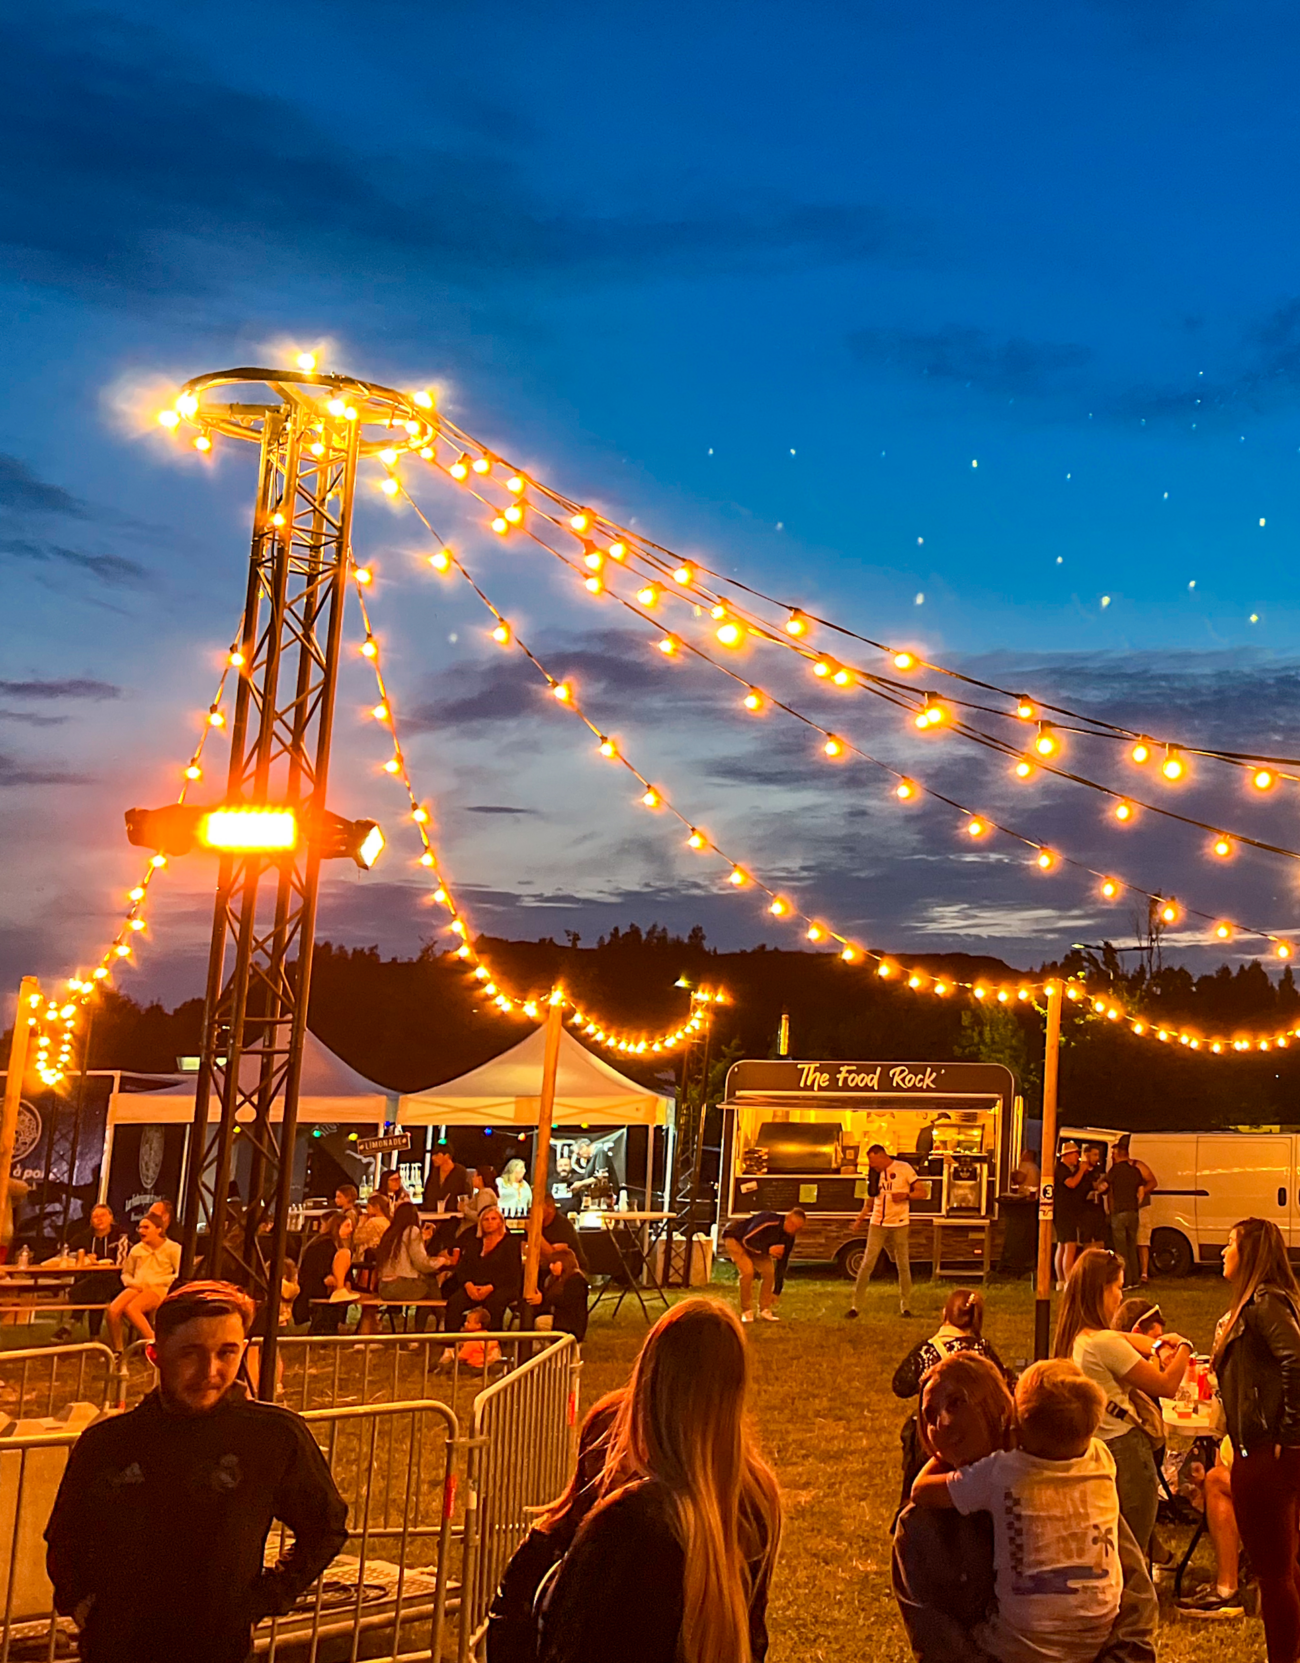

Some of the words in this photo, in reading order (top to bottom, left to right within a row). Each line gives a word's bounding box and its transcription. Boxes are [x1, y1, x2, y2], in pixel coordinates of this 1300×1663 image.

[797, 1063, 830, 1092] The
[836, 1065, 882, 1091] Food
[364, 1138, 402, 1151] LIMONADE
